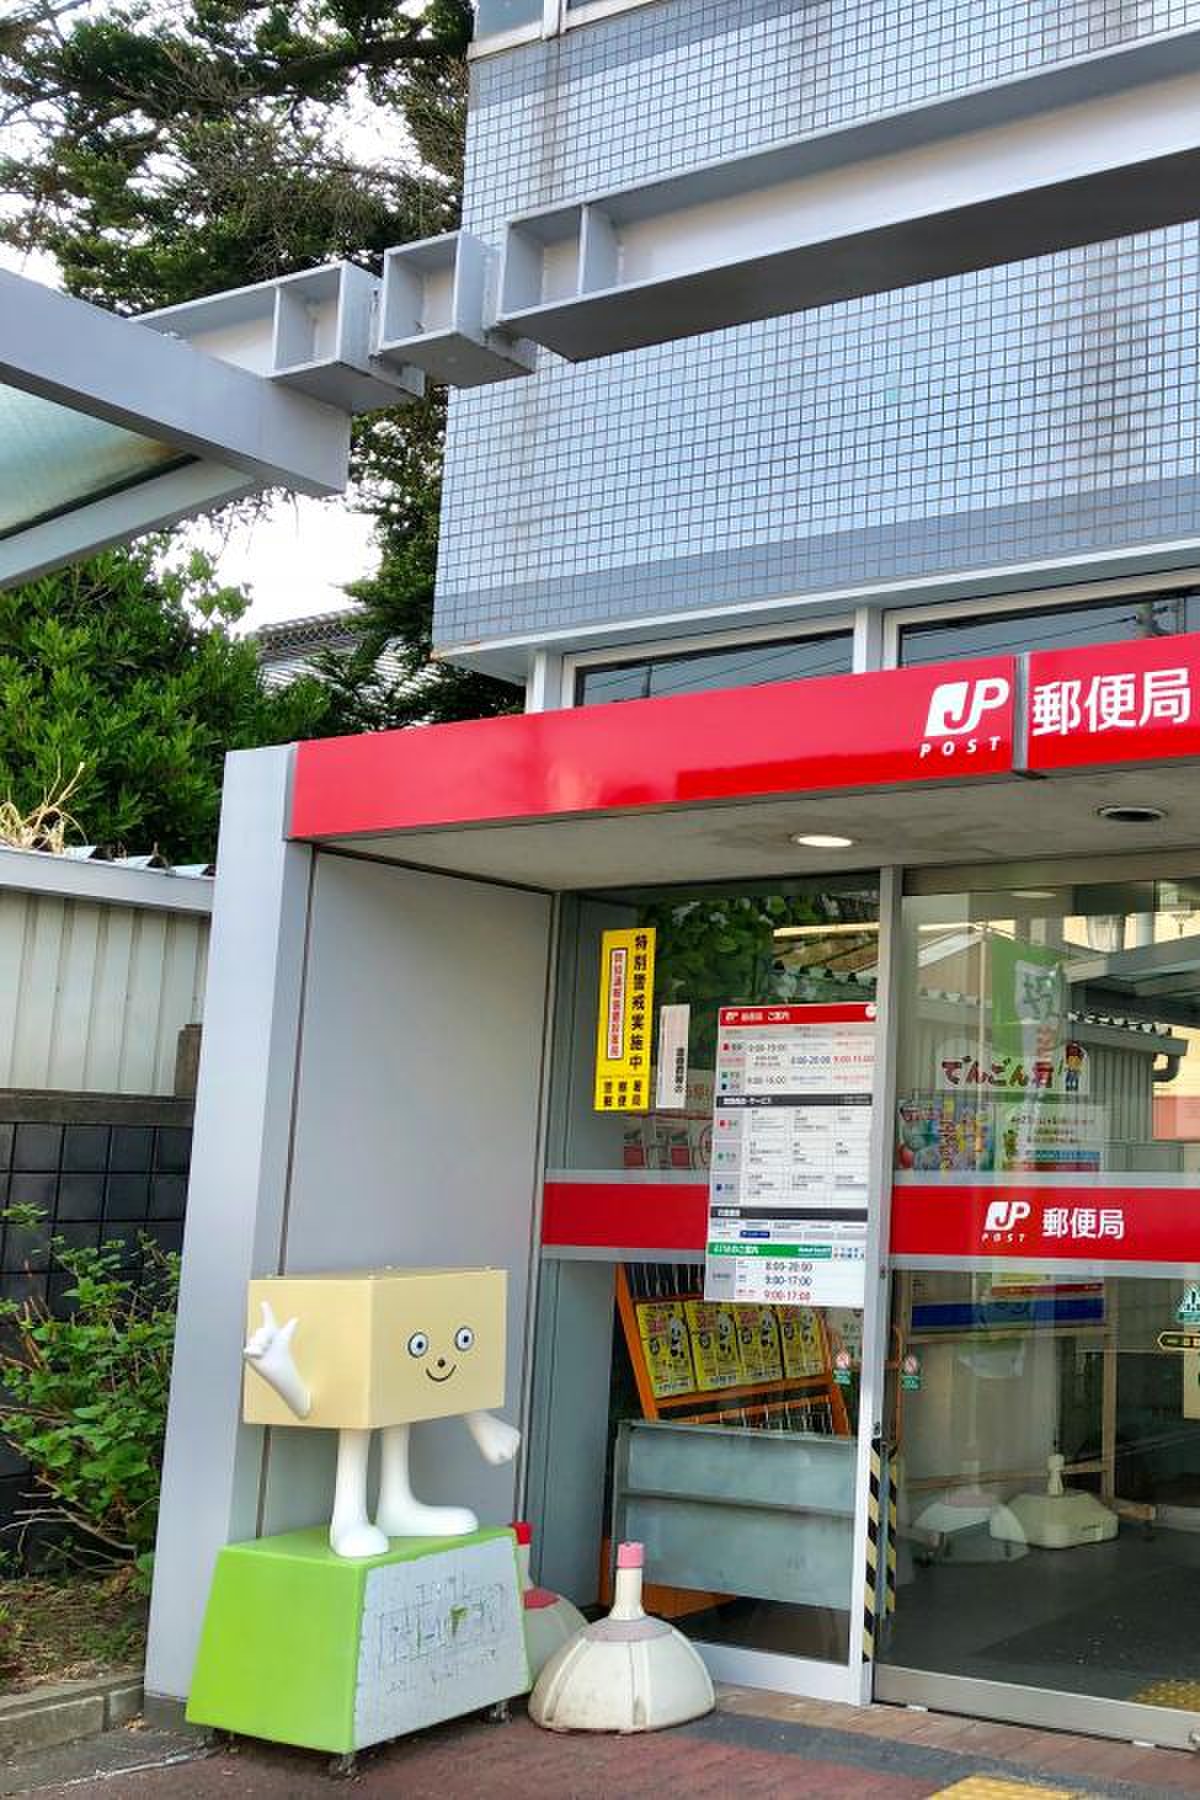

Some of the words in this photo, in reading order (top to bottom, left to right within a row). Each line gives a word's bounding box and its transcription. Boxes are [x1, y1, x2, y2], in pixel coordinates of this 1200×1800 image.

[924, 677, 1010, 737] JP
[1031, 667, 1191, 736] 郵便局
[919, 736, 1002, 758] POST
[985, 1201, 1031, 1231] JP
[1042, 1207, 1125, 1239] 郵便局
[982, 1232, 1025, 1242] POST
